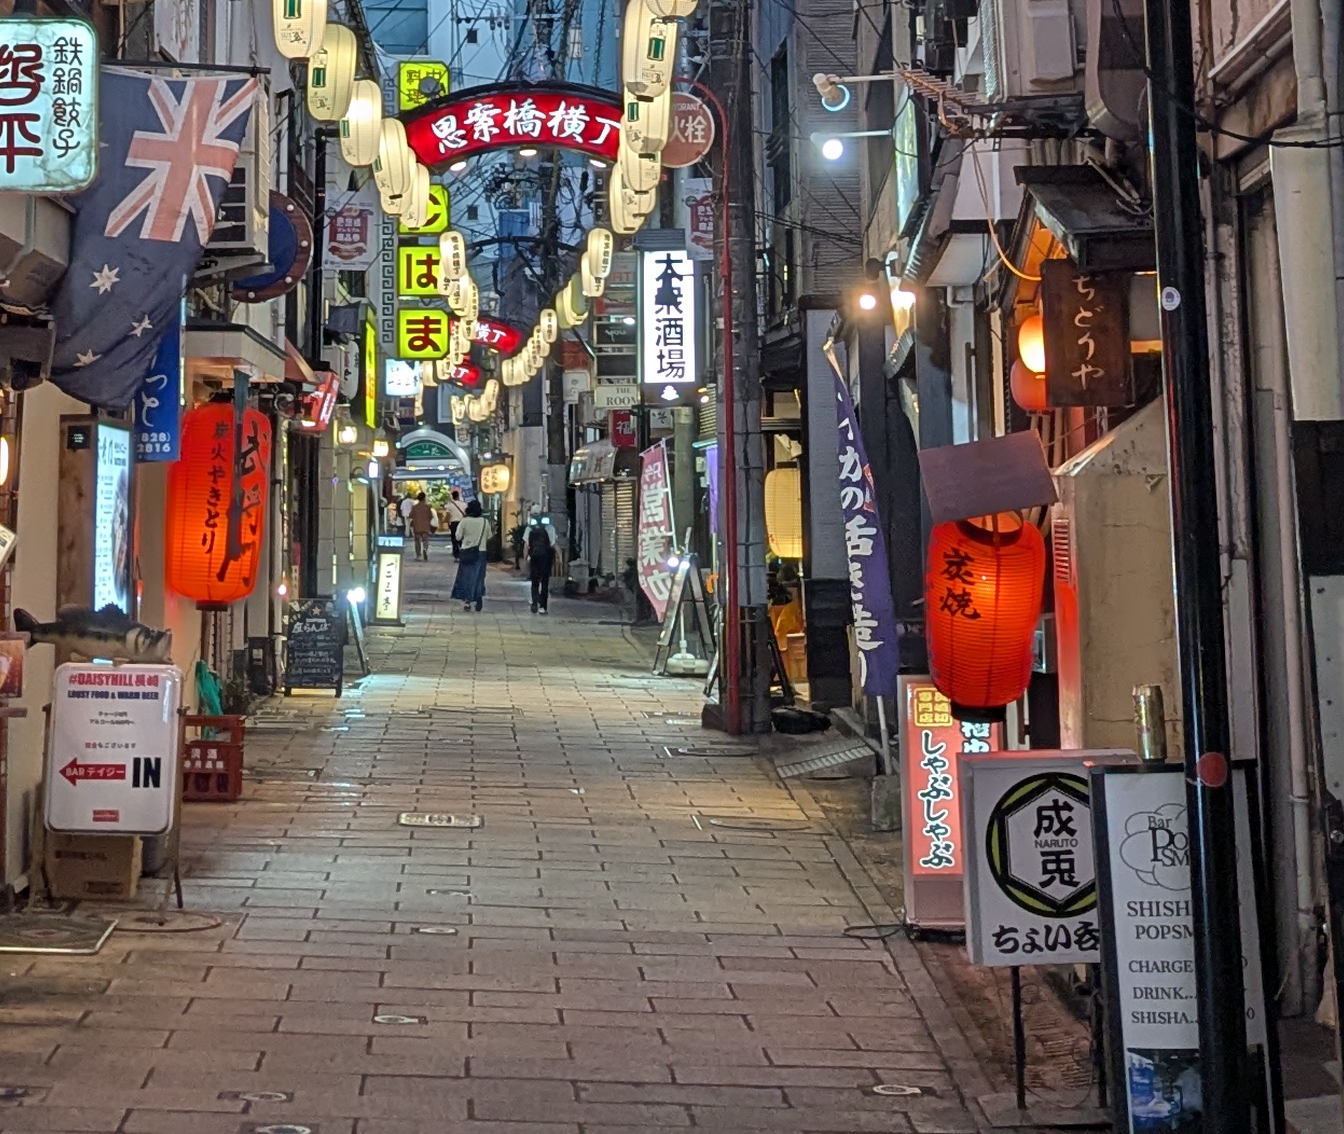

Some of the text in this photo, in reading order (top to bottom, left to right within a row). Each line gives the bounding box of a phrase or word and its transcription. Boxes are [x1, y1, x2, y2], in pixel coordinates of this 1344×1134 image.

[52, 36, 84, 160] 鉄鍋餃子
[431, 98, 622, 154] 思案橋横丁
[669, 114, 707, 144] 火栓
[137, 443, 171, 453] 2816
[201, 420, 231, 554] 炭火やきとり
[940, 548, 982, 622] 炭焼
[91, 690, 109, 699] FOOD
[141, 691, 159, 700] BEER
[132, 757, 162, 788] IN
[918, 730, 955, 868] しゃぶしゃぶ
[1034, 798, 1078, 839] 成
[1148, 816, 1173, 830] Bar
[1034, 838, 1078, 849] NARUTO
[1126, 900, 1192, 917] SHISH
[1128, 960, 1194, 974] CHARGE
